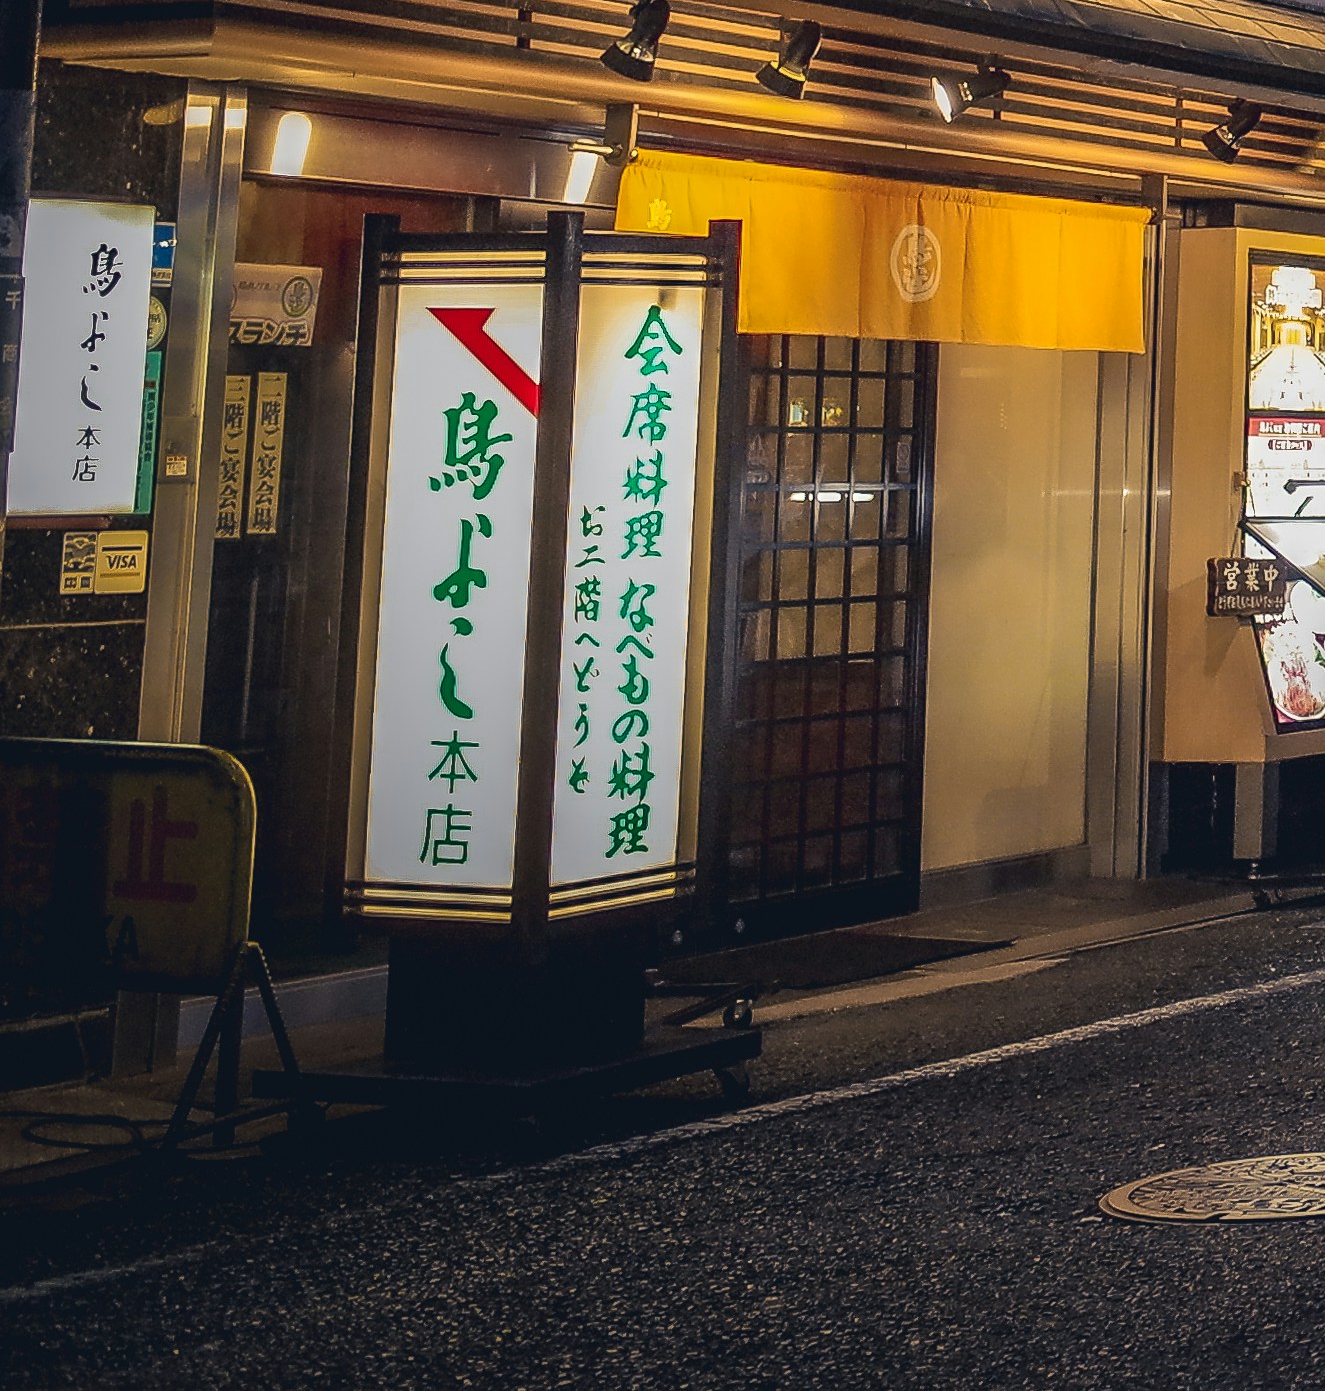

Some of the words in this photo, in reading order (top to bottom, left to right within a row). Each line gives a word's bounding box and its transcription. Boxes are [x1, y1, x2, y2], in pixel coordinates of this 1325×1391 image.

[72, 243, 123, 482] 鳥よし本店
[215, 377, 246, 537] 三階ご宴会場
[253, 375, 283, 532] 二階ご宴会場
[620, 304, 683, 560] 会席料理
[106, 555, 138, 570] VISA
[419, 391, 514, 867] 鳥よし本店
[1223, 561, 1279, 592] 営業中
[603, 578, 657, 860] なべもの料理
